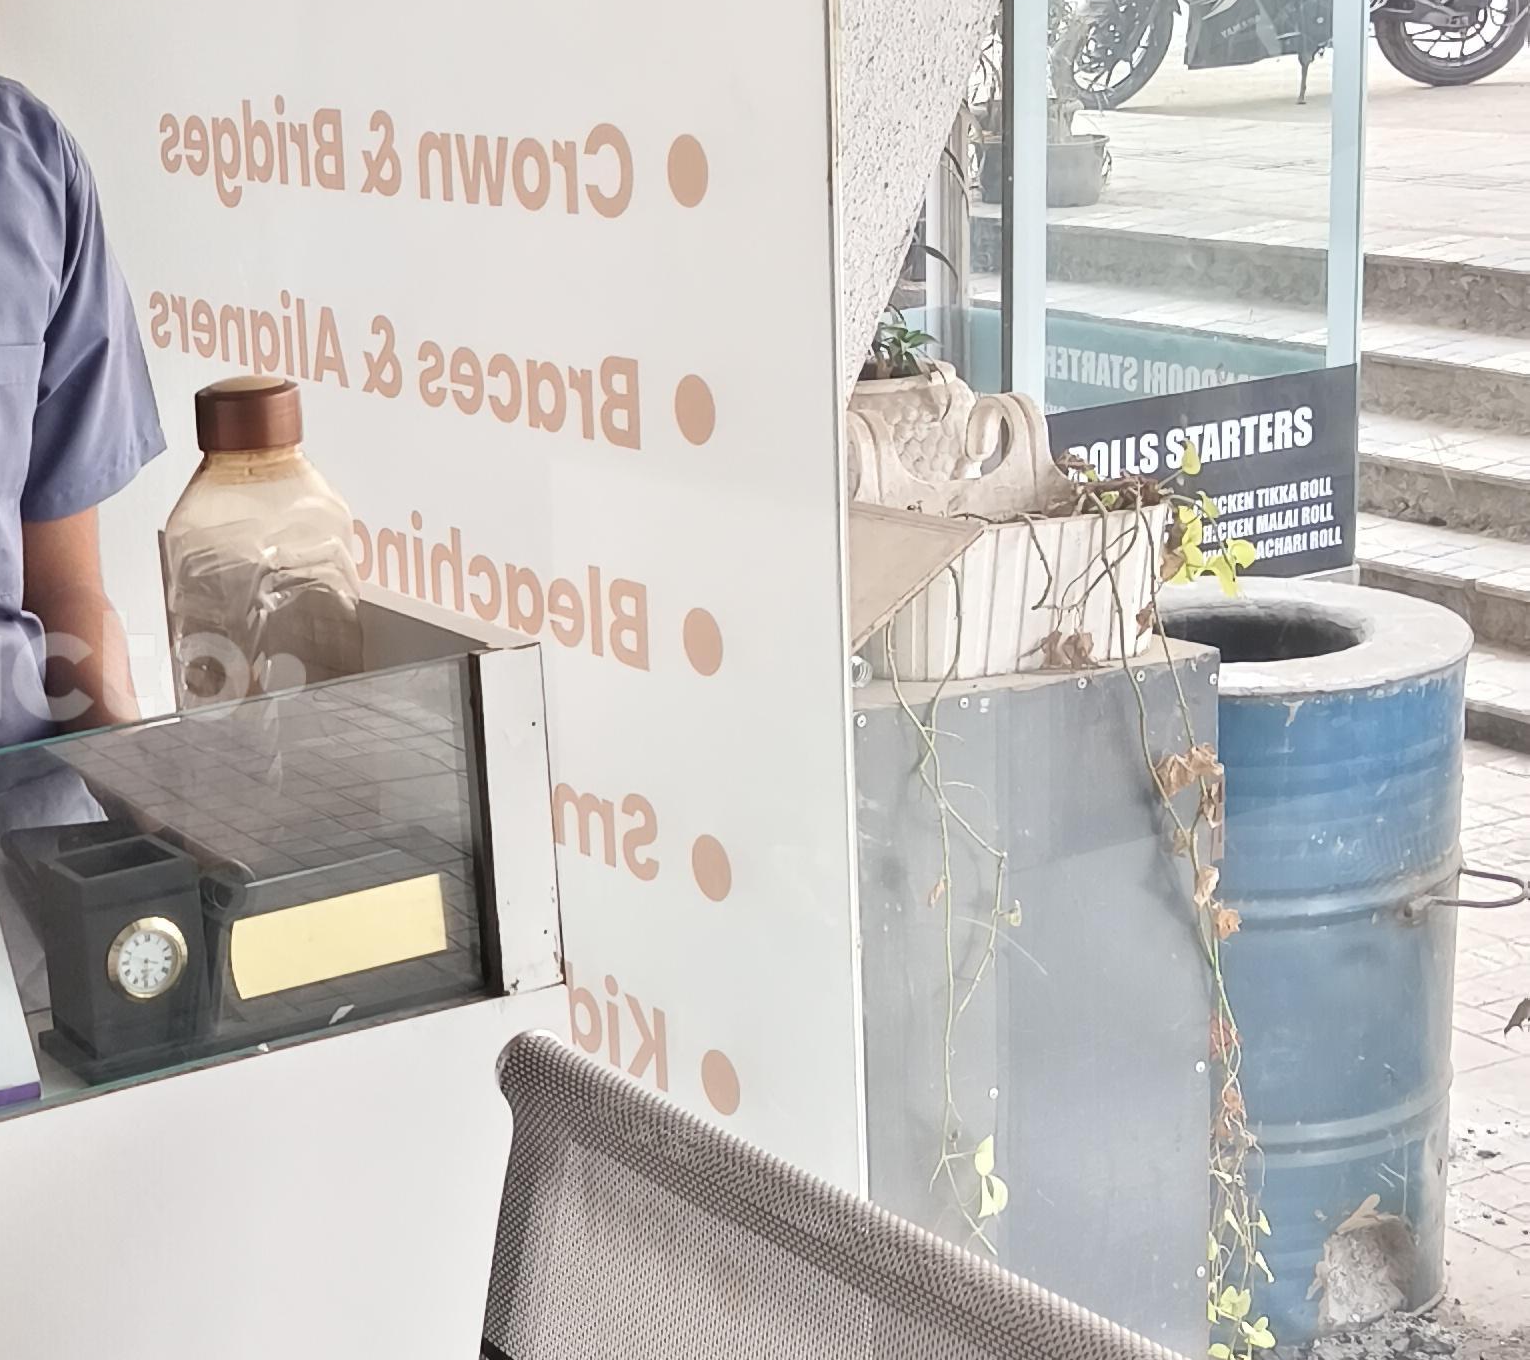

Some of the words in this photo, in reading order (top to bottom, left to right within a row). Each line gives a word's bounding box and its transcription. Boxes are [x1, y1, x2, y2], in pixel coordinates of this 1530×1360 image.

[1165, 405, 1314, 470] STARTERS
[1193, 490, 1255, 518] CCKEN
[1256, 482, 1299, 508] TIKKA
[1299, 476, 1334, 500] ROLL
[1201, 516, 1254, 544] HCKEN
[1255, 508, 1299, 535] MALAI
[1301, 501, 1334, 526] ROLL
[1255, 532, 1308, 560] ACHARI
[1309, 525, 1343, 551] ROLL
